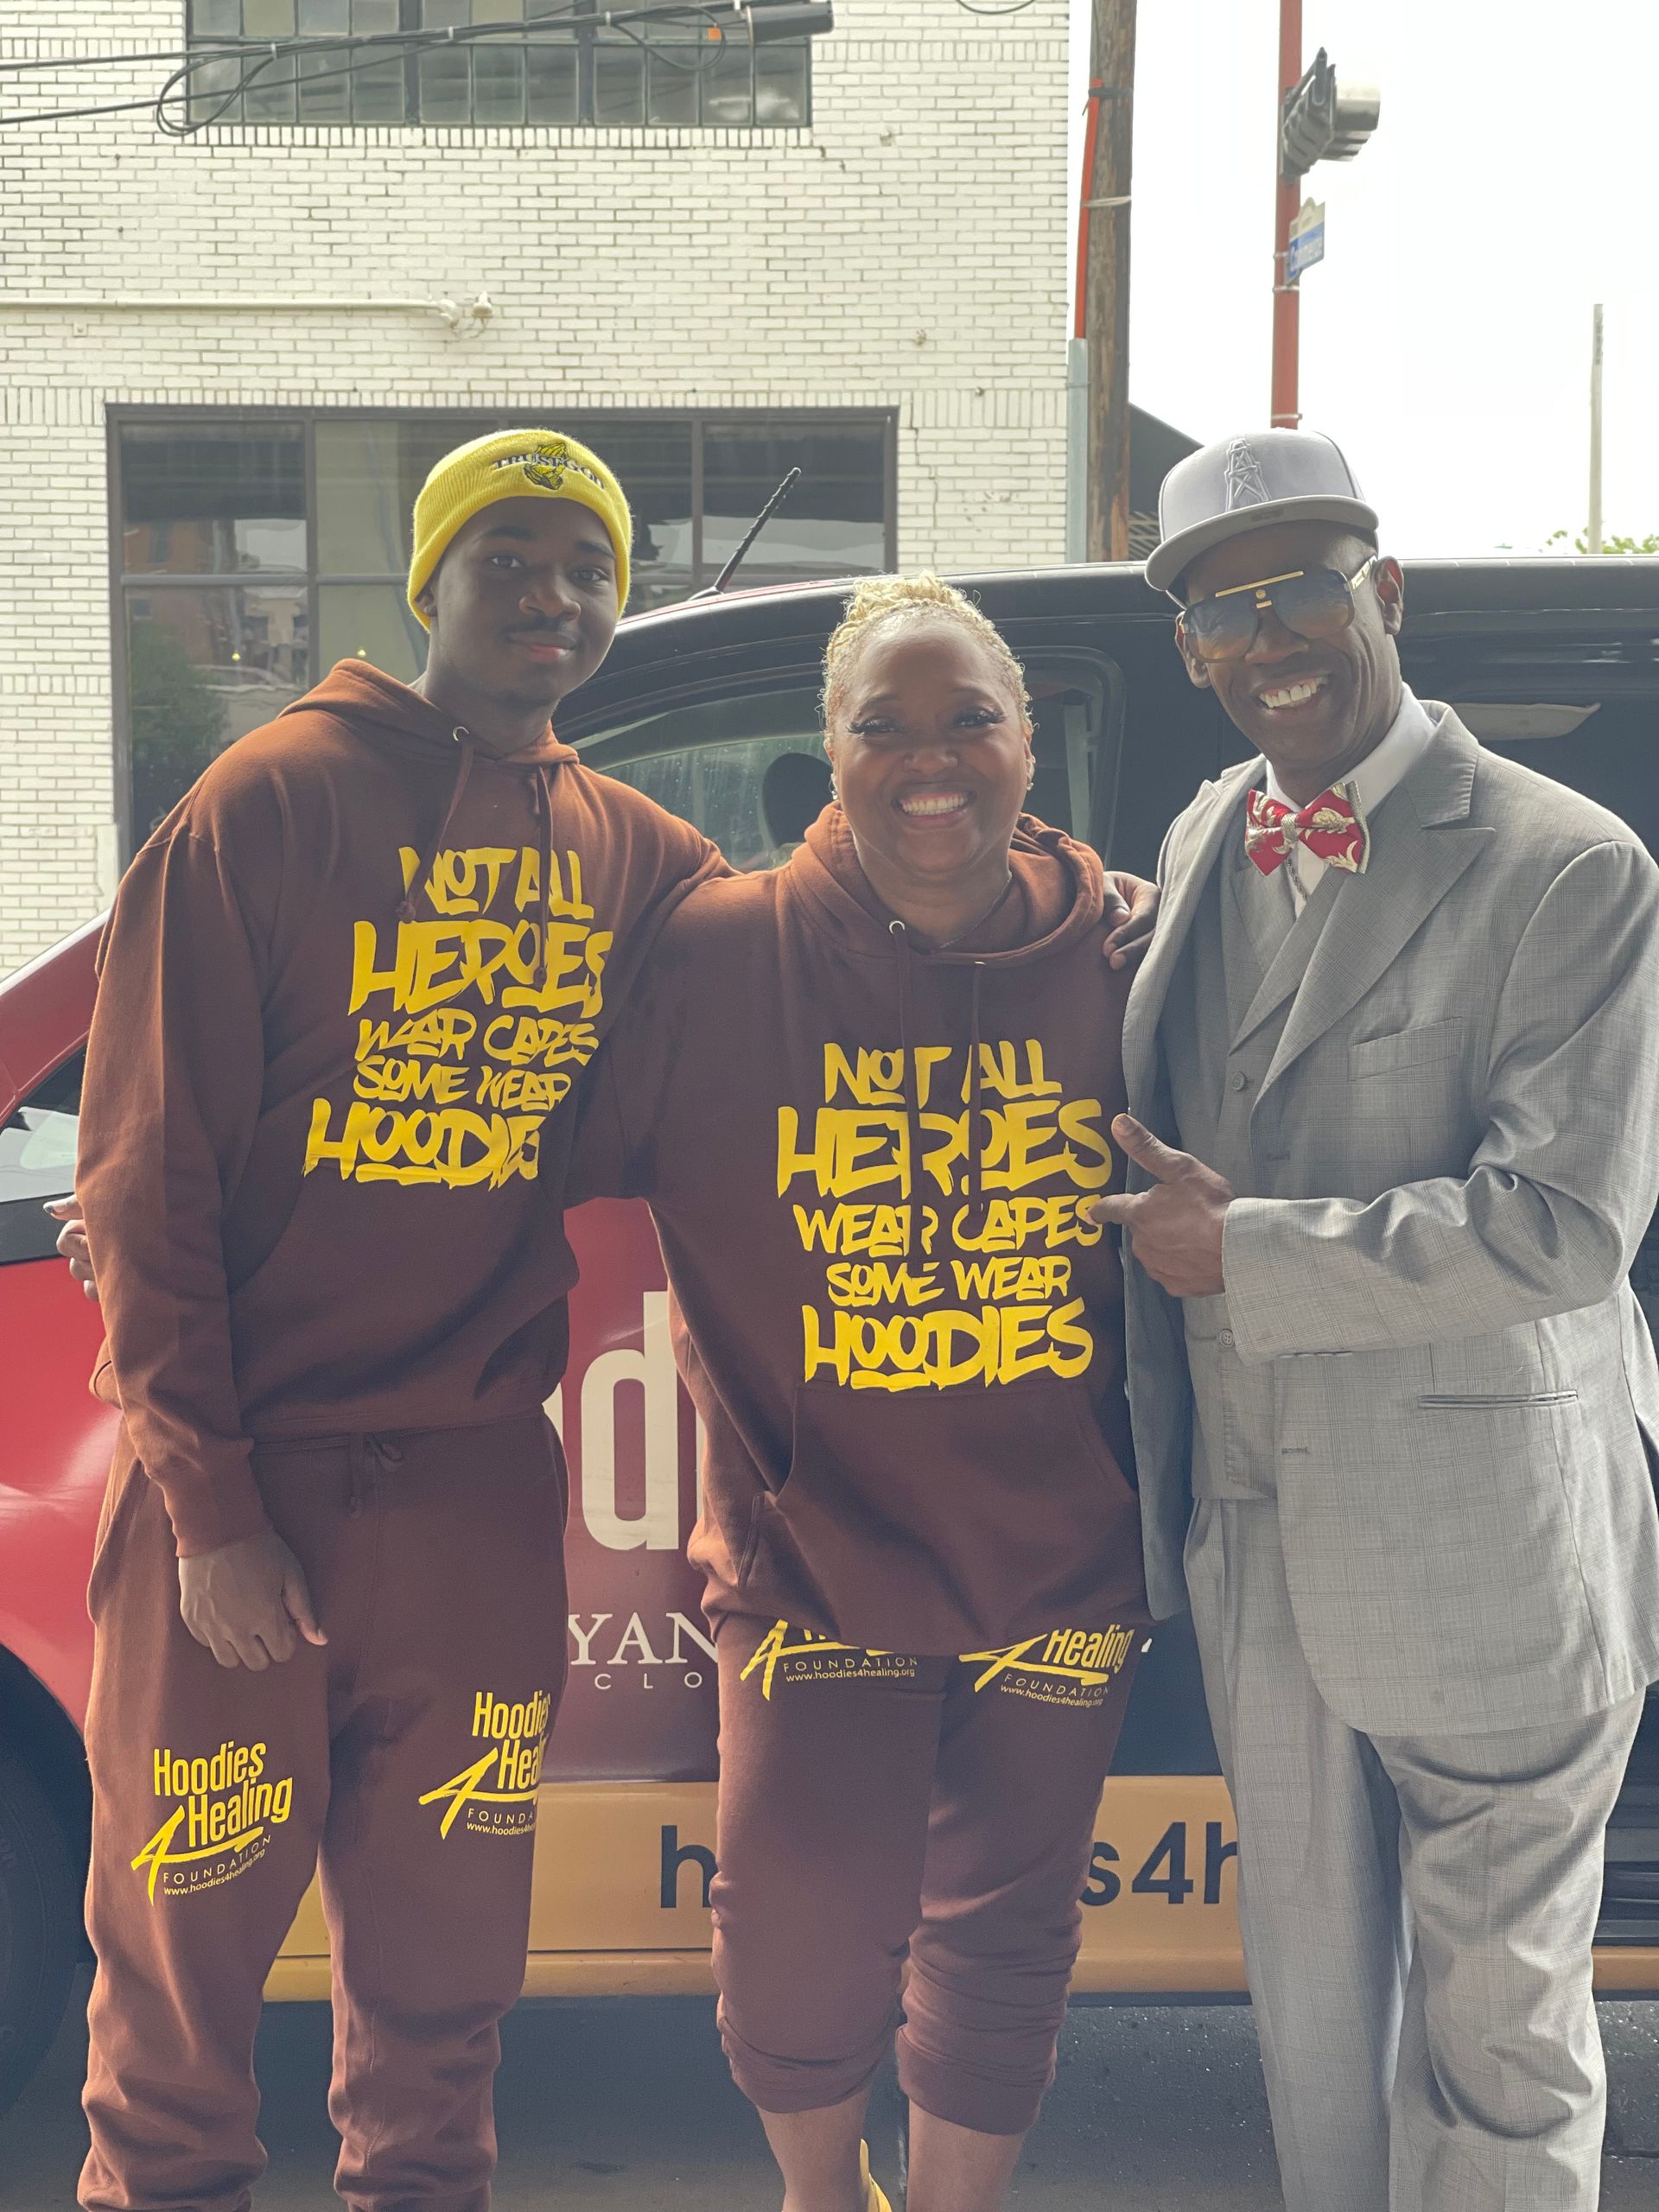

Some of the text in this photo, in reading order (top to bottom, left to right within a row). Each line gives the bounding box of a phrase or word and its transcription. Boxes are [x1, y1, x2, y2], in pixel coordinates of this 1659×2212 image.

[398, 846, 594, 919] NOT ALL
[348, 919, 613, 1018] HEROES
[353, 1054, 572, 1111] SOME WEAR
[824, 1039, 1063, 1109] NOT ALL
[777, 1099, 1113, 1199] HEROES
[793, 1194, 1103, 1256] WEAR CAPES
[826, 1255, 1071, 1306] SOME WEAR
[802, 1296, 1094, 1393] HOODIES
[783, 1656, 918, 1674] FOUNDATION
[785, 1668, 916, 1682] www.hoodies4healing.org
[1042, 1624, 1135, 1674] Healing
[1004, 1673, 1110, 1698] FOUNDATION
[154, 1740, 267, 1796] Hoodies
[188, 1777, 293, 1847] Healing
[163, 1834, 271, 1885] FOUNDATION
[163, 1848, 265, 1895] www.hoodies4healing.org
